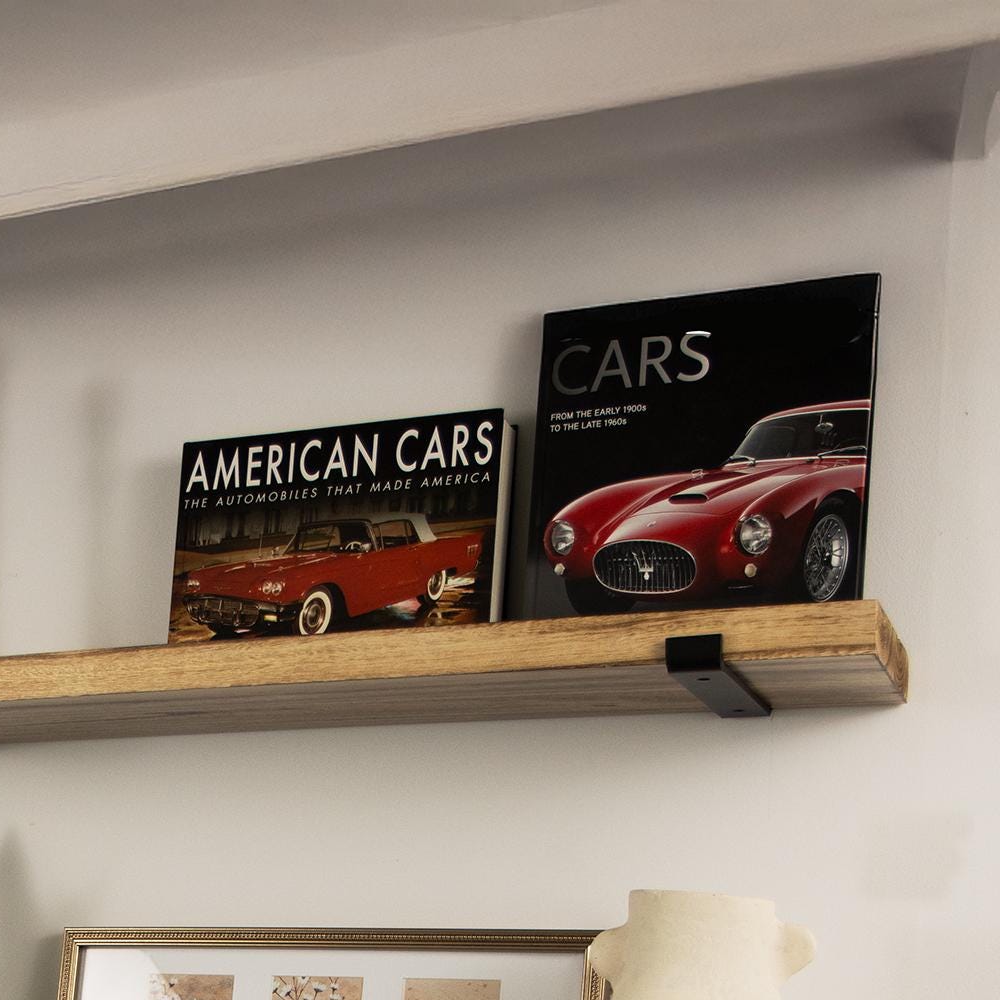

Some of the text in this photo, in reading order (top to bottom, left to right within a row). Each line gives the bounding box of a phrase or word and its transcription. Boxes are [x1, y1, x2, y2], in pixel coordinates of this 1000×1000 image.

[551, 330, 712, 396] CARS
[550, 403, 647, 421] FROM THE EARLY 1900s
[550, 417, 627, 433] TO THE LATE 1960s
[185, 421, 494, 493] AMERICAN CARS
[184, 472, 491, 511] THE AUTOMOBILES THAT MADE AMERICA
